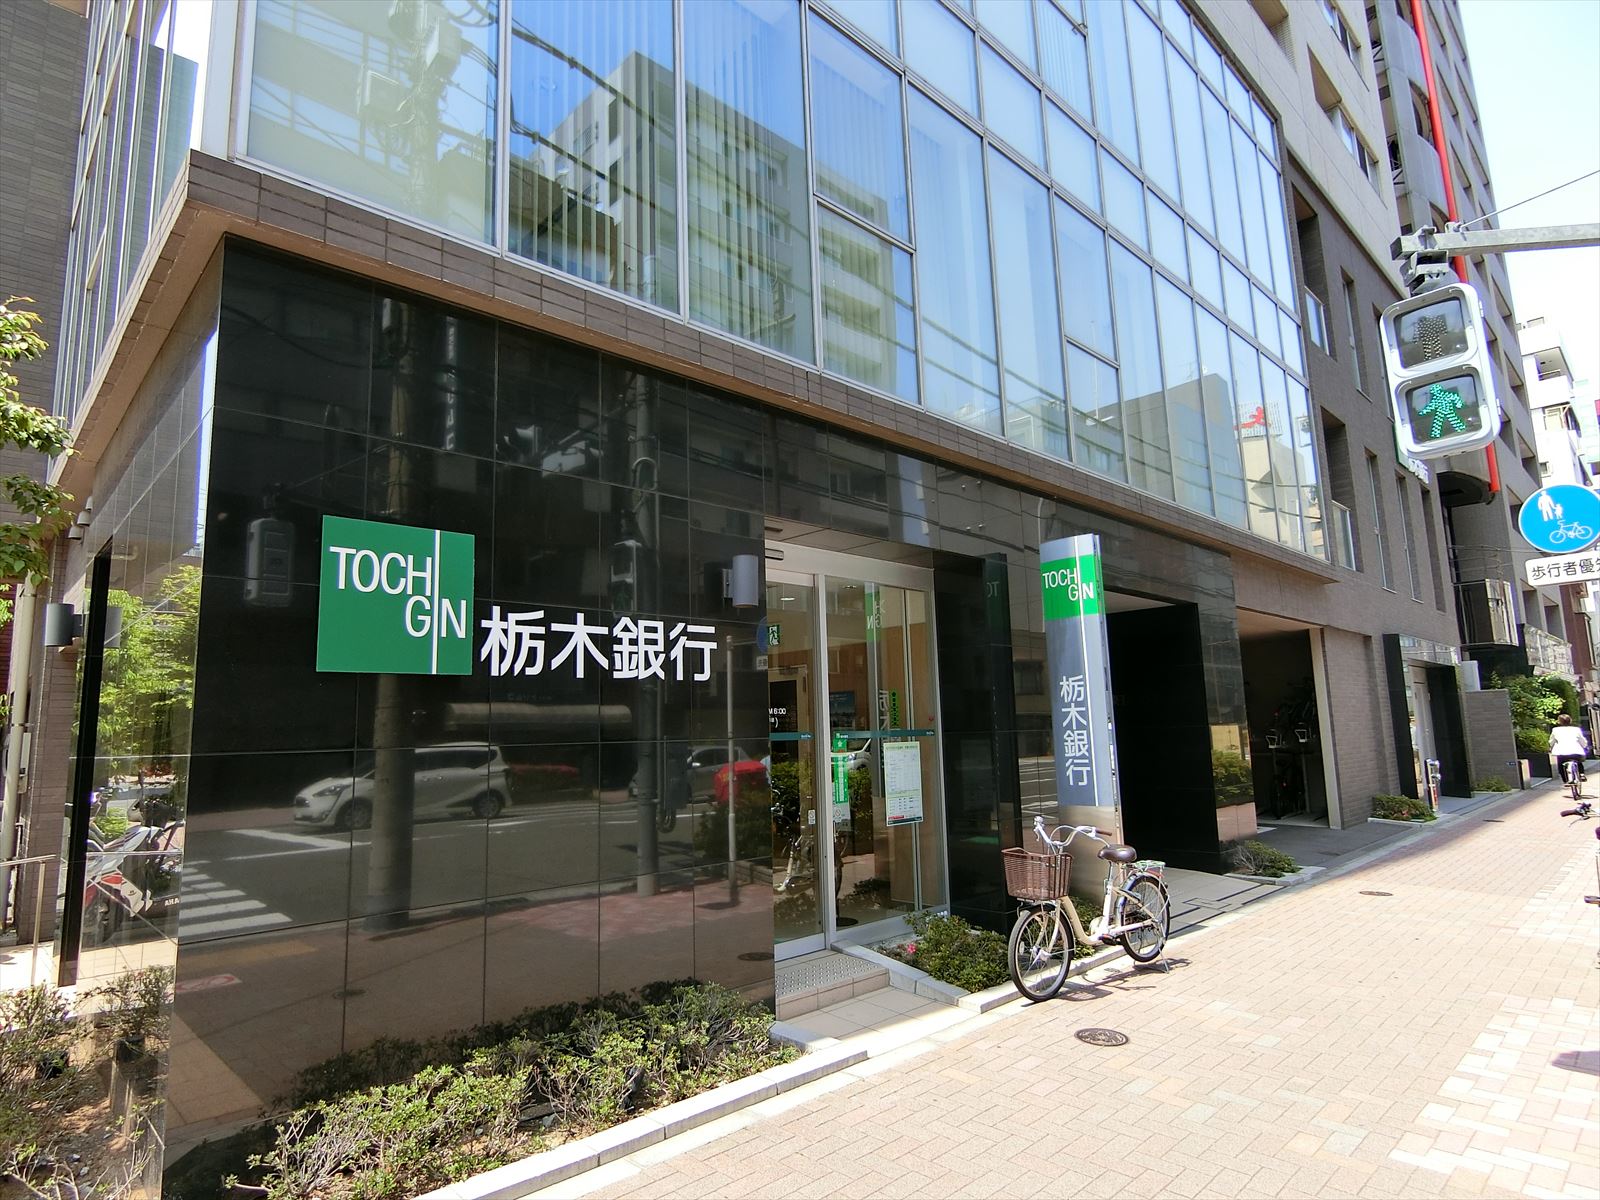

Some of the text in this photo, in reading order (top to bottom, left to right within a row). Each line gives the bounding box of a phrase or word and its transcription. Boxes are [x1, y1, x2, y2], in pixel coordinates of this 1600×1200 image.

[480, 604, 718, 681] 栃木銀行
[1059, 674, 1091, 786] 栃木銀行
